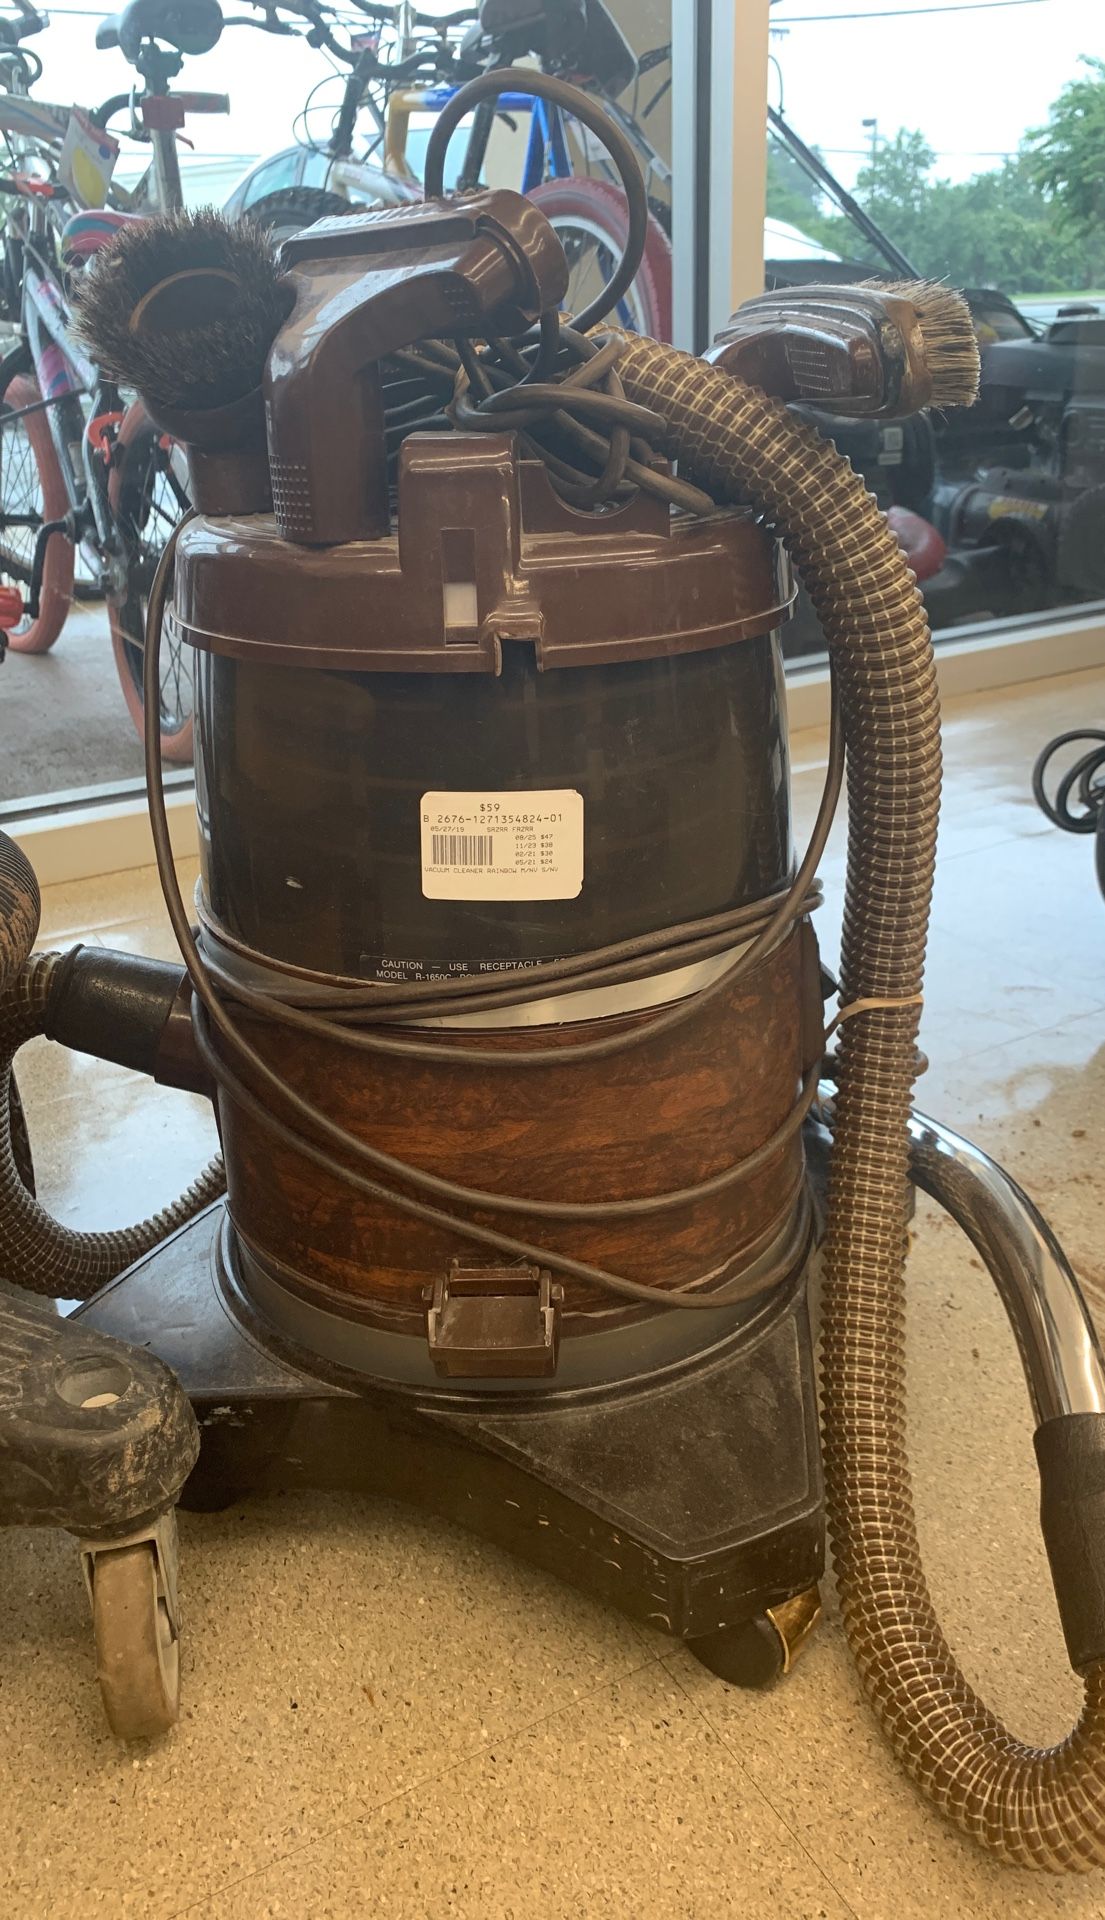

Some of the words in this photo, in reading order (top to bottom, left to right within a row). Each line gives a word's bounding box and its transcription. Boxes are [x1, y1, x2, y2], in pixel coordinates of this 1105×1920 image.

[480, 803, 500, 812] $59
[437, 813, 563, 824] 2676-1271354824-01
[430, 825, 465, 833] 05/27/19
[515, 858, 536, 866] 05/21
[424, 866, 450, 874] VACUUM
[453, 866, 483, 874] CLEANER
[381, 959, 423, 970] CAUTION
[449, 962, 468, 971] USE
[480, 960, 543, 971] RECEPTACLE
[376, 969, 408, 980] MODEL
